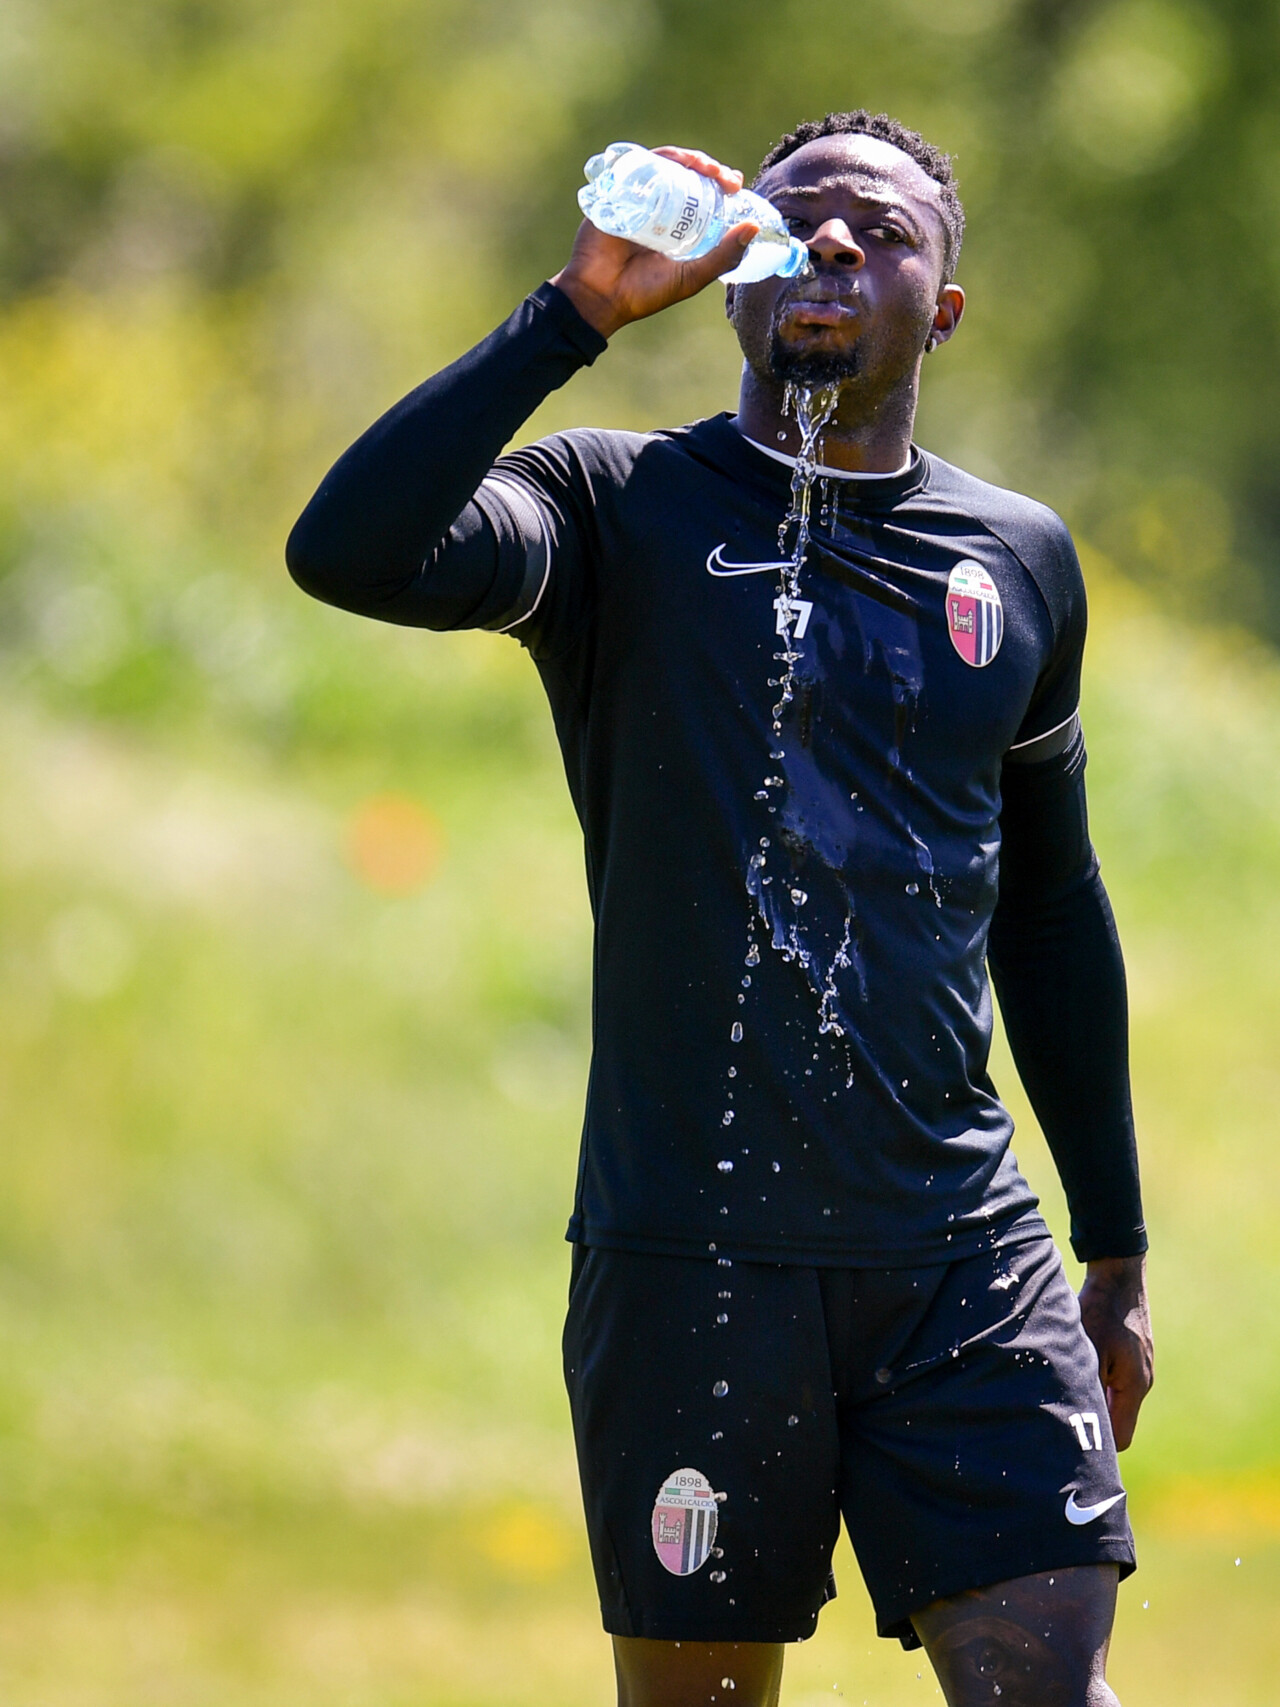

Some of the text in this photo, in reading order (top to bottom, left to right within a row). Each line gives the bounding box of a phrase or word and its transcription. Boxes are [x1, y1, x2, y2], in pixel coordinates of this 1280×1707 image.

[670, 196, 699, 240] nerea
[773, 597, 813, 639] 17
[1068, 1412, 1102, 1451] 17
[659, 1497, 687, 1506] ASCOLI
[674, 1476, 702, 1488] 1898
